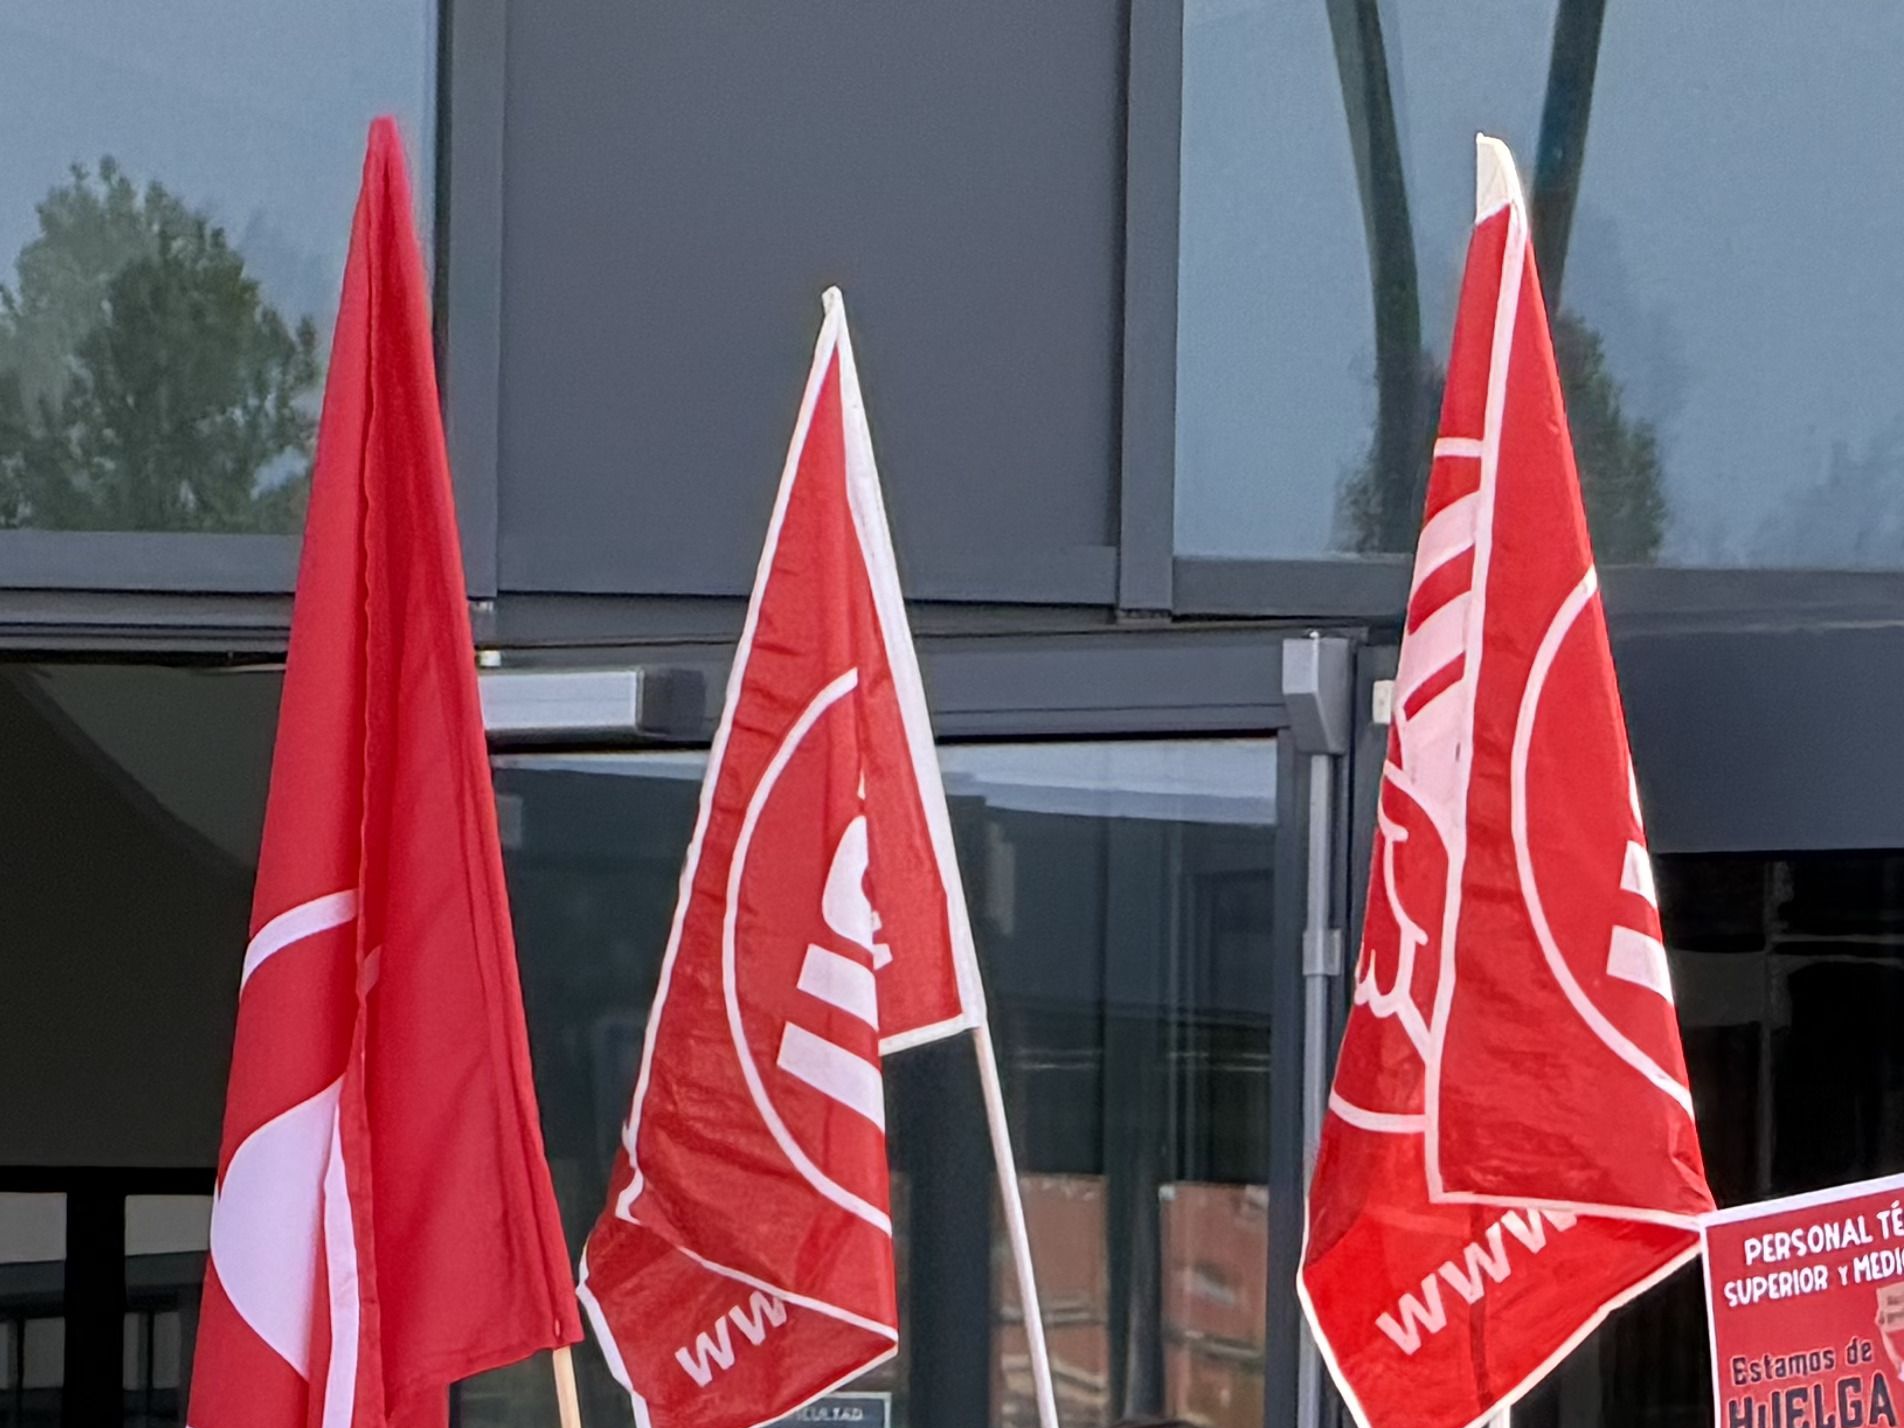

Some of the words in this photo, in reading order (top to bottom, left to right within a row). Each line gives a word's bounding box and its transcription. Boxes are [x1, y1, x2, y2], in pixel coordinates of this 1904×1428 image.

[1744, 1215, 1872, 1266] PERSONAL
[1877, 1201, 1904, 1240] TÉ
[1724, 1265, 1828, 1308] SUPERIOR
[1853, 1246, 1904, 1284] MEDI
[1732, 1348, 1835, 1386] Estamos
[1846, 1337, 1873, 1365] de
